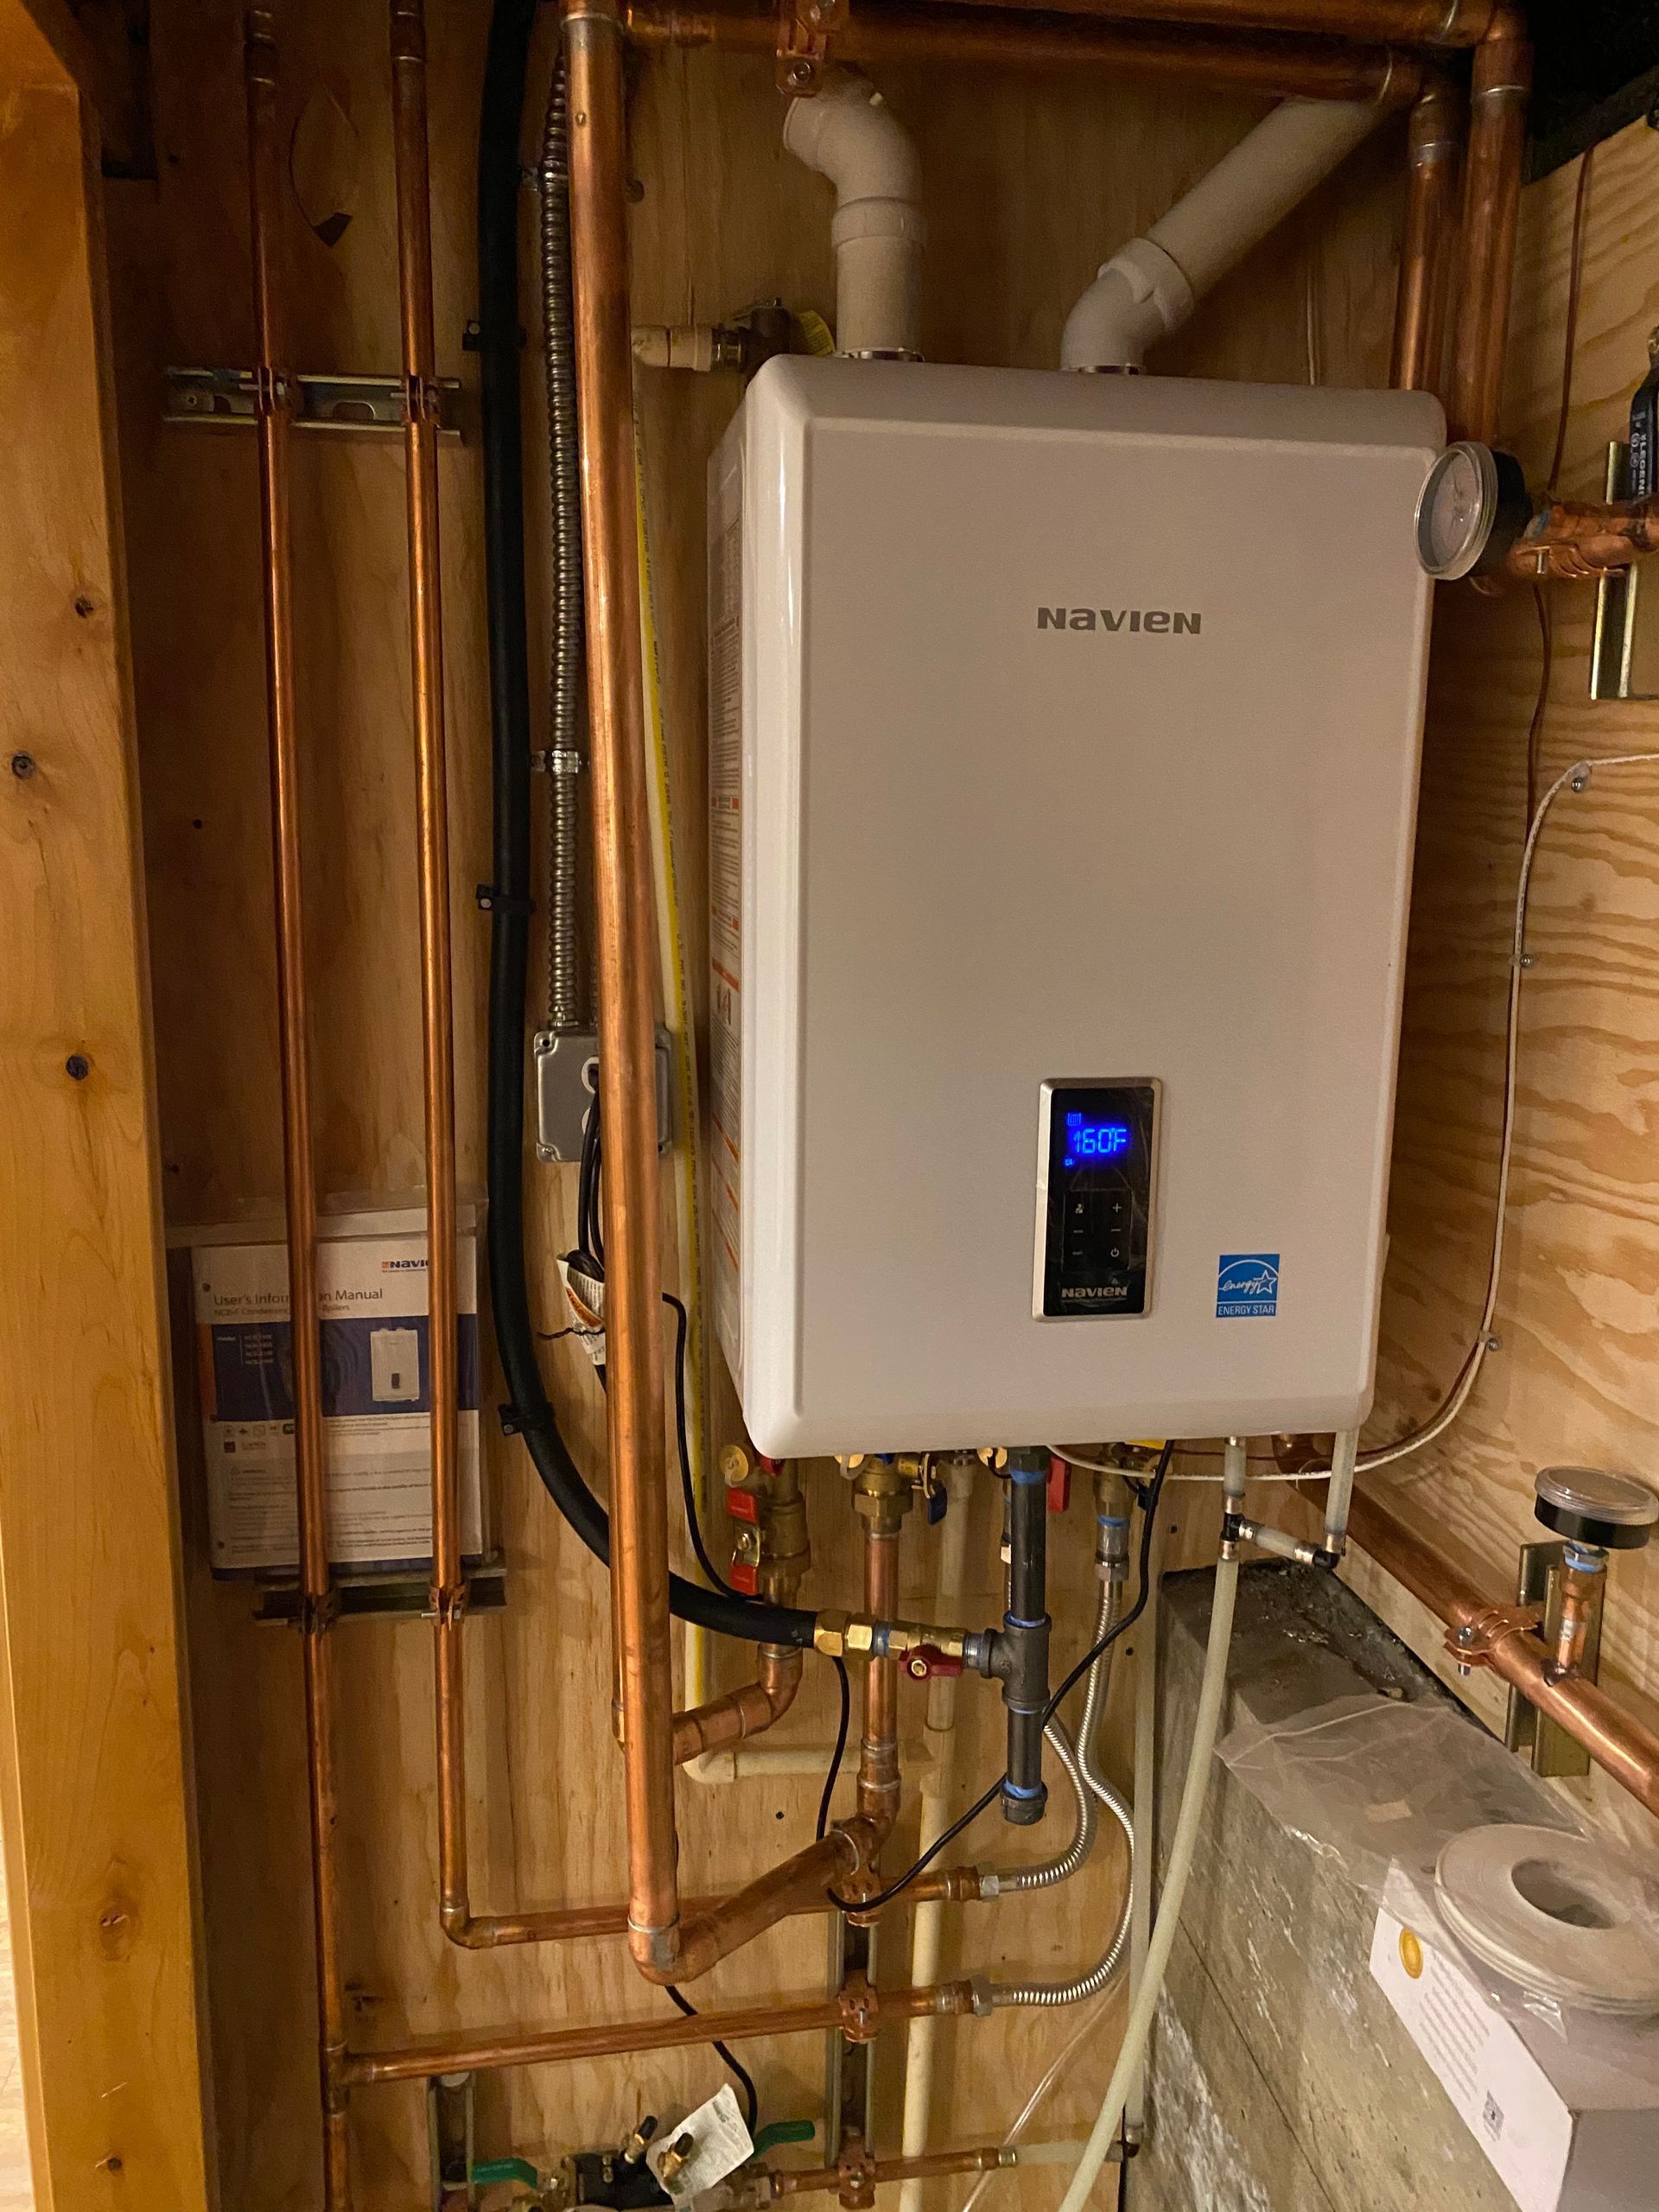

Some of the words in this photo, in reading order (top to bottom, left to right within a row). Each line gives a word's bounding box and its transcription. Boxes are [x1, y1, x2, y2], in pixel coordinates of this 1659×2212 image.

[213, 1294, 251, 1306] User's
[255, 1292, 332, 1304] Inforon
[335, 1287, 383, 1300] Manual
[1217, 1306, 1251, 1315] ENERGY
[1253, 1304, 1274, 1314] STAR
